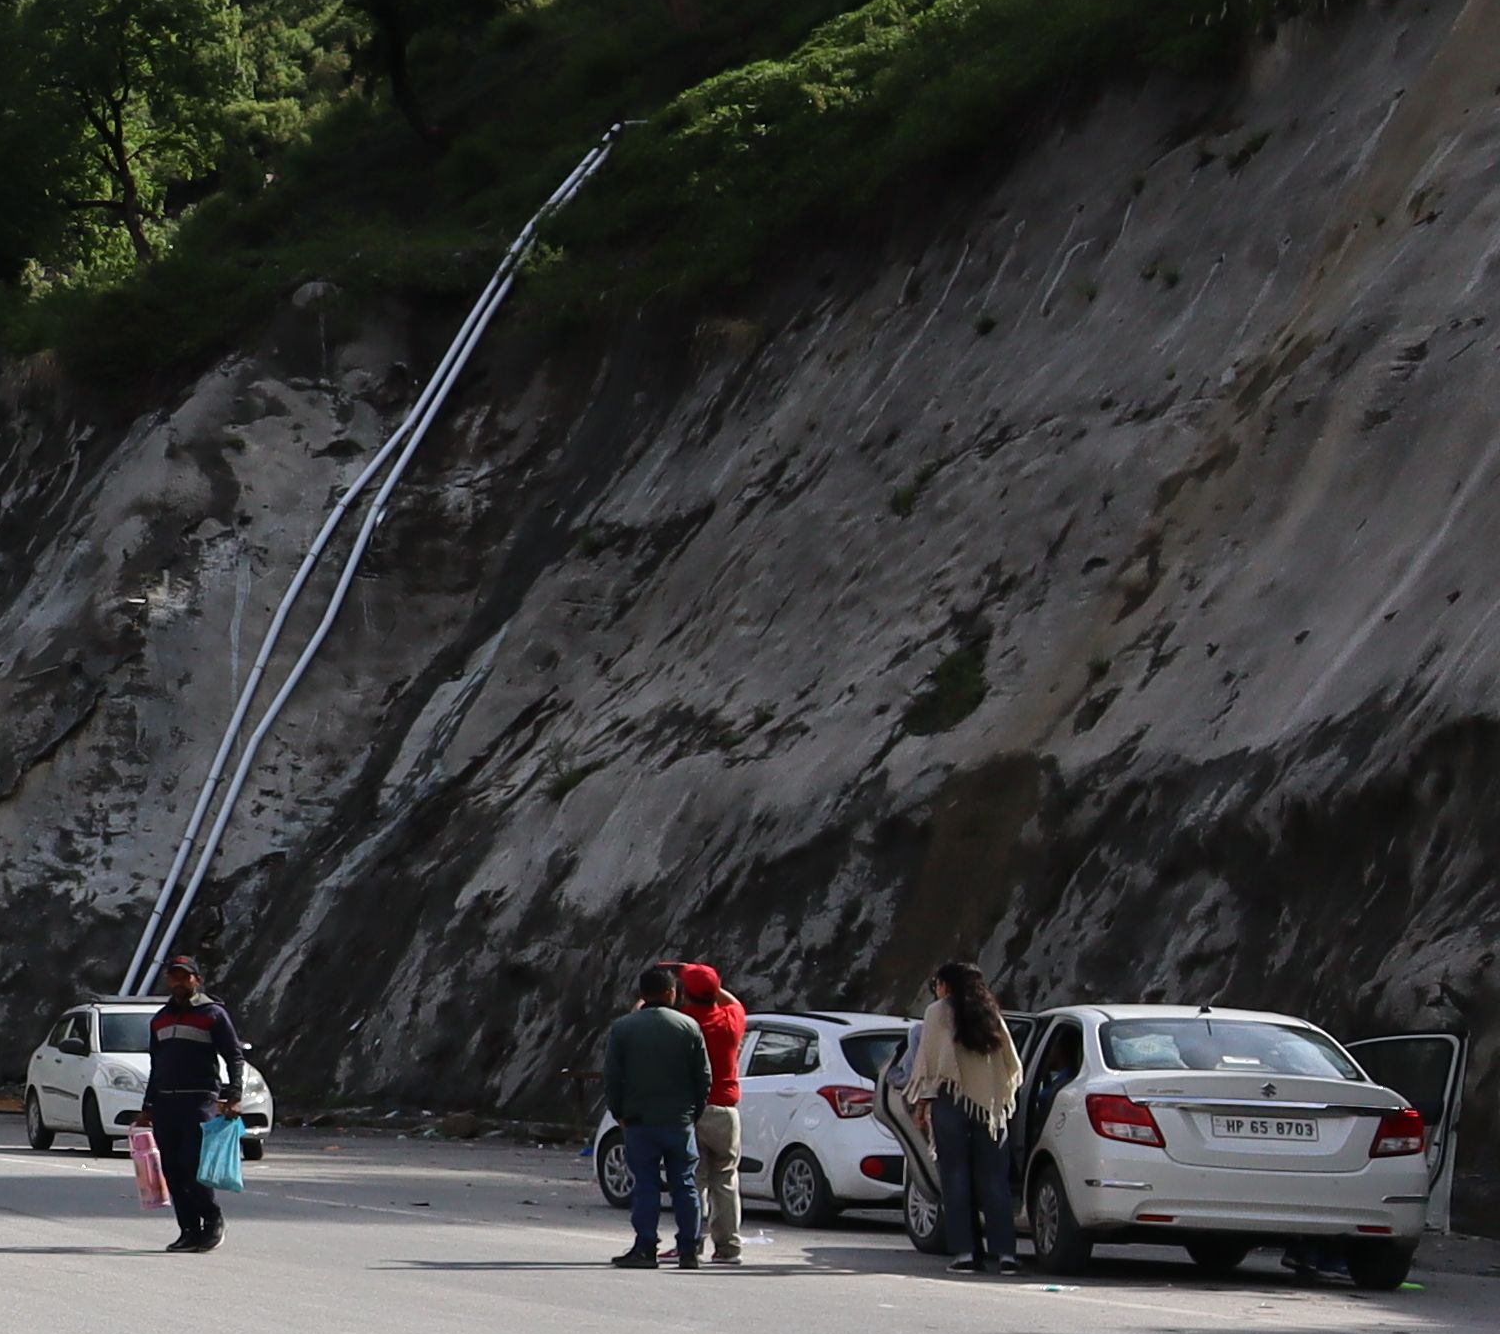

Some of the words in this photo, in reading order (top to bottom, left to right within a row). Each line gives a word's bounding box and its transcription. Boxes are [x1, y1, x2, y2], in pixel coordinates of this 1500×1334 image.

[1226, 1120, 1243, 1134] HP
[1250, 1120, 1268, 1135] 65
[1276, 1121, 1313, 1136] 8703
